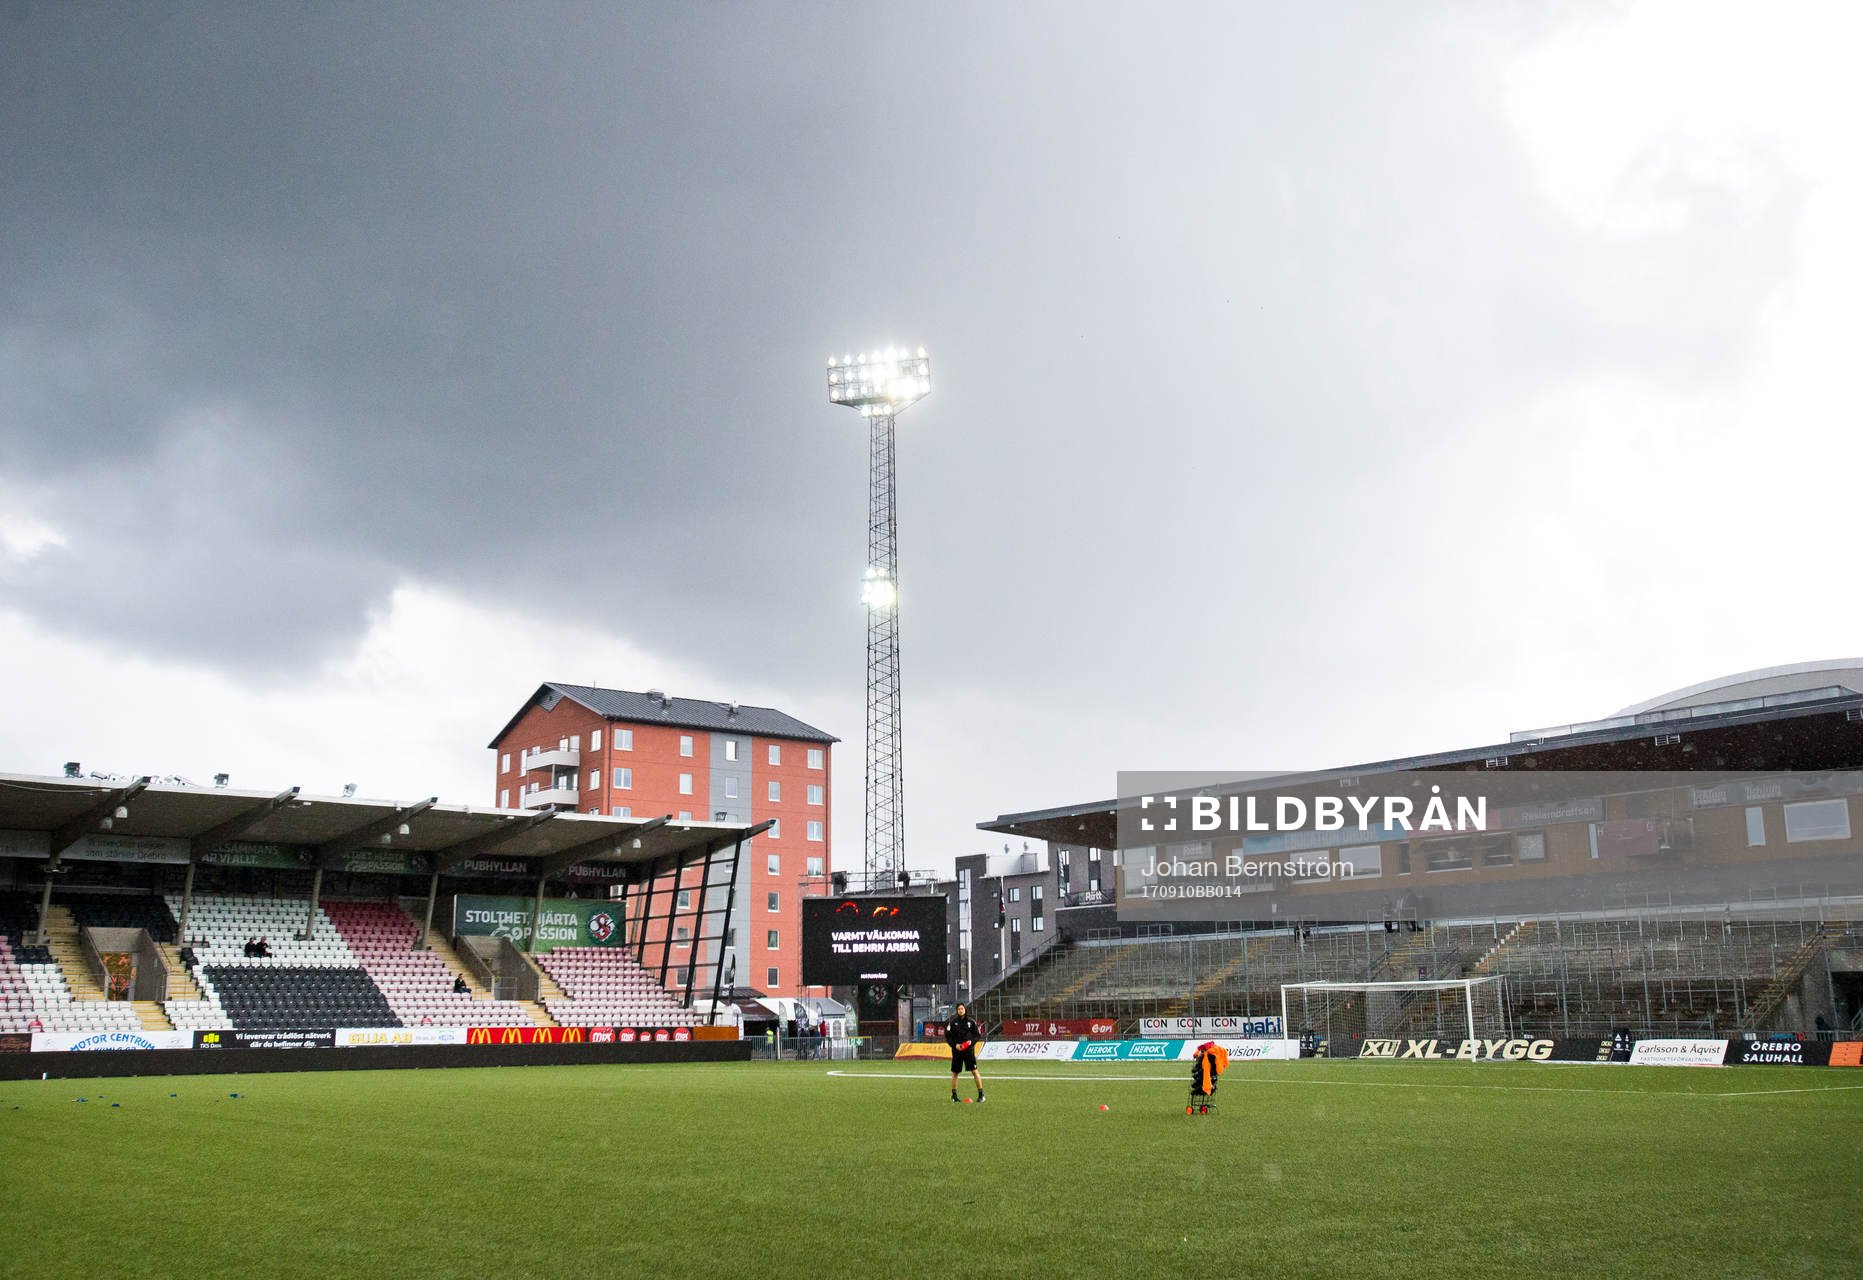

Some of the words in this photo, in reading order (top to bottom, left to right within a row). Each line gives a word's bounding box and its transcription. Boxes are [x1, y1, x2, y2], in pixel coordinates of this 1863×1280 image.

[1521, 805, 1596, 822] Reklamproffsen
[464, 859, 527, 873] PUBHYLLAN
[568, 865, 627, 878] PUBHYLLAN
[832, 931, 865, 941] VARMT
[866, 929, 920, 940] VÄLKOMNA
[832, 943, 852, 953] TILL
[853, 943, 885, 953] BEHRN
[886, 942, 920, 952] ARENA
[1144, 1019, 1168, 1029] ICON
[1177, 1018, 1202, 1028] ICON
[1212, 1017, 1237, 1028] ICON
[235, 1032, 243, 1040] Vi
[592, 1030, 613, 1043] mix
[70, 1034, 108, 1052] MOTOR
[110, 1033, 156, 1051] CENTRUM
[263, 1040, 273, 1048] du
[1006, 1042, 1050, 1054] ORRBYS
[1751, 1040, 1802, 1051] ÖREBRO
[1227, 1045, 1261, 1057] vision
[1400, 1039, 1554, 1060] XL-BYGG
[1638, 1044, 1678, 1053] Carlsson
[1680, 1045, 1687, 1053] &
[1690, 1043, 1720, 1056] Åqvist
[1743, 1053, 1804, 1064] SALUHALL
